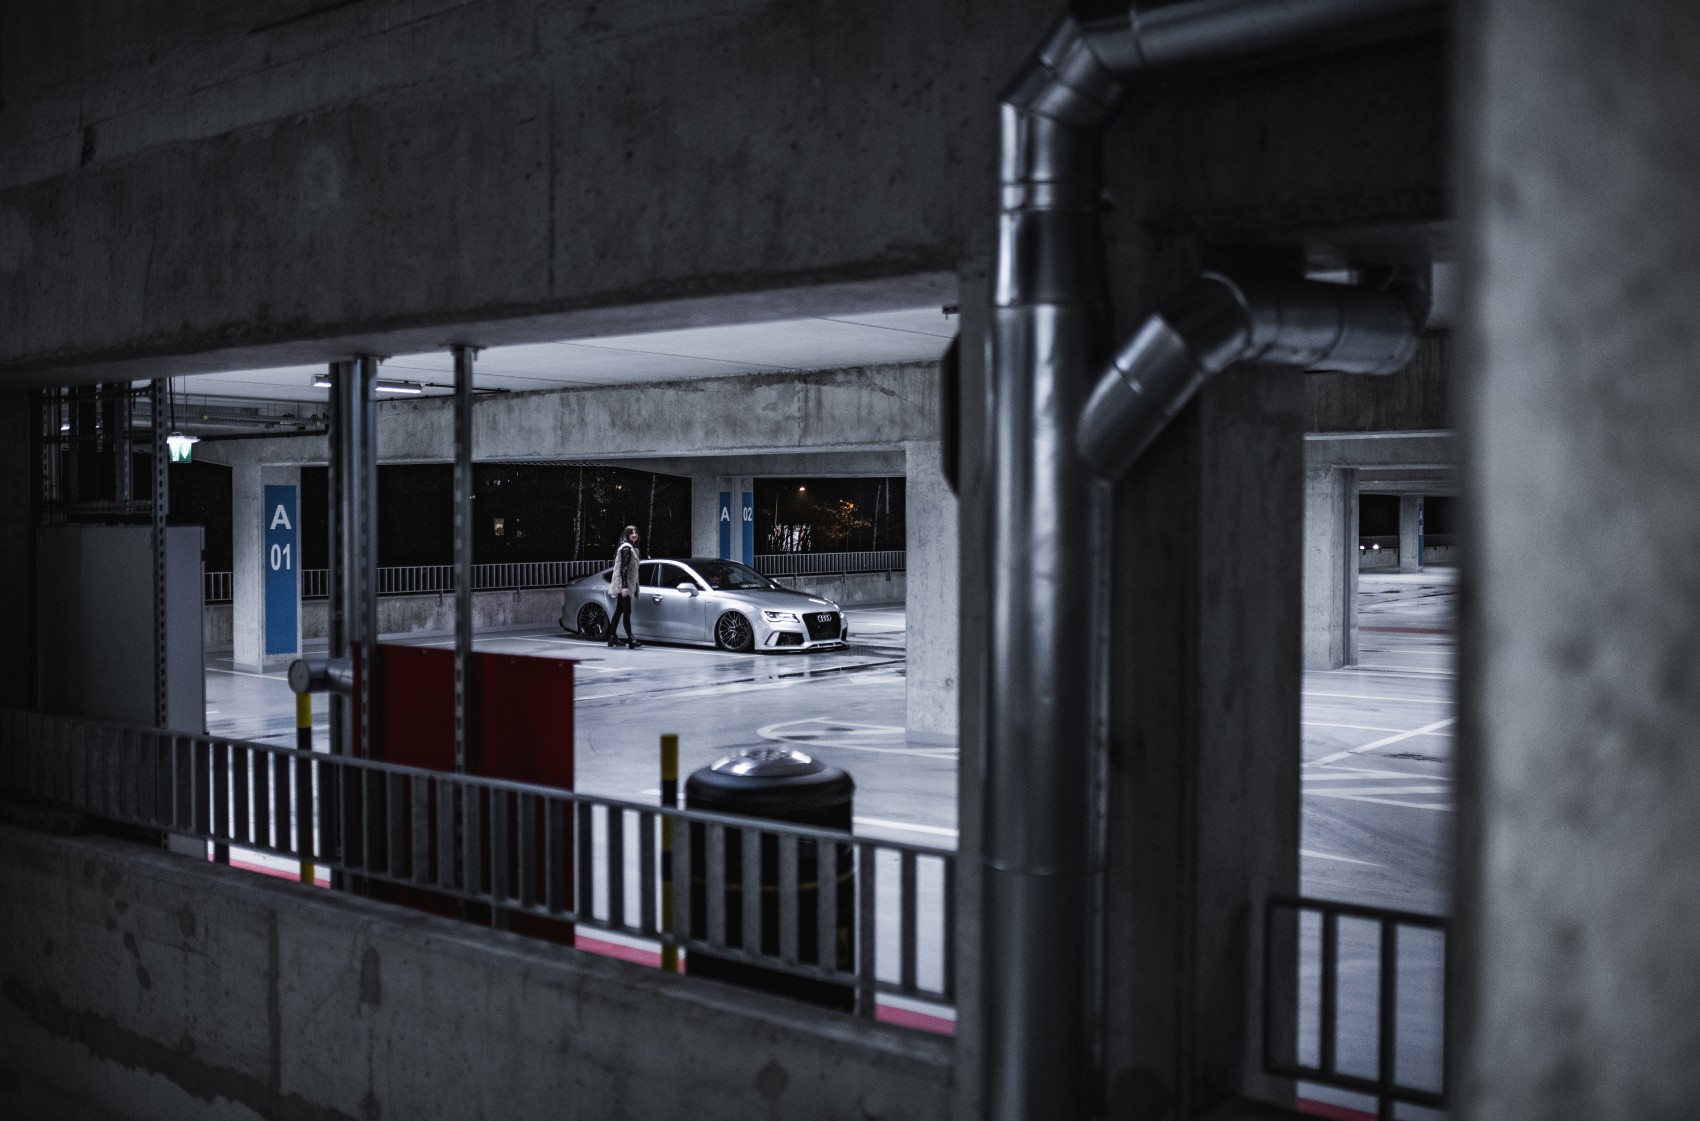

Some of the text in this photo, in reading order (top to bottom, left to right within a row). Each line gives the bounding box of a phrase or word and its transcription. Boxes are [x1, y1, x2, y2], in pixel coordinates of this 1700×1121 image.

[270, 504, 292, 530] A
[720, 506, 730, 522] A
[743, 506, 753, 522] 02
[270, 543, 291, 571] 01
